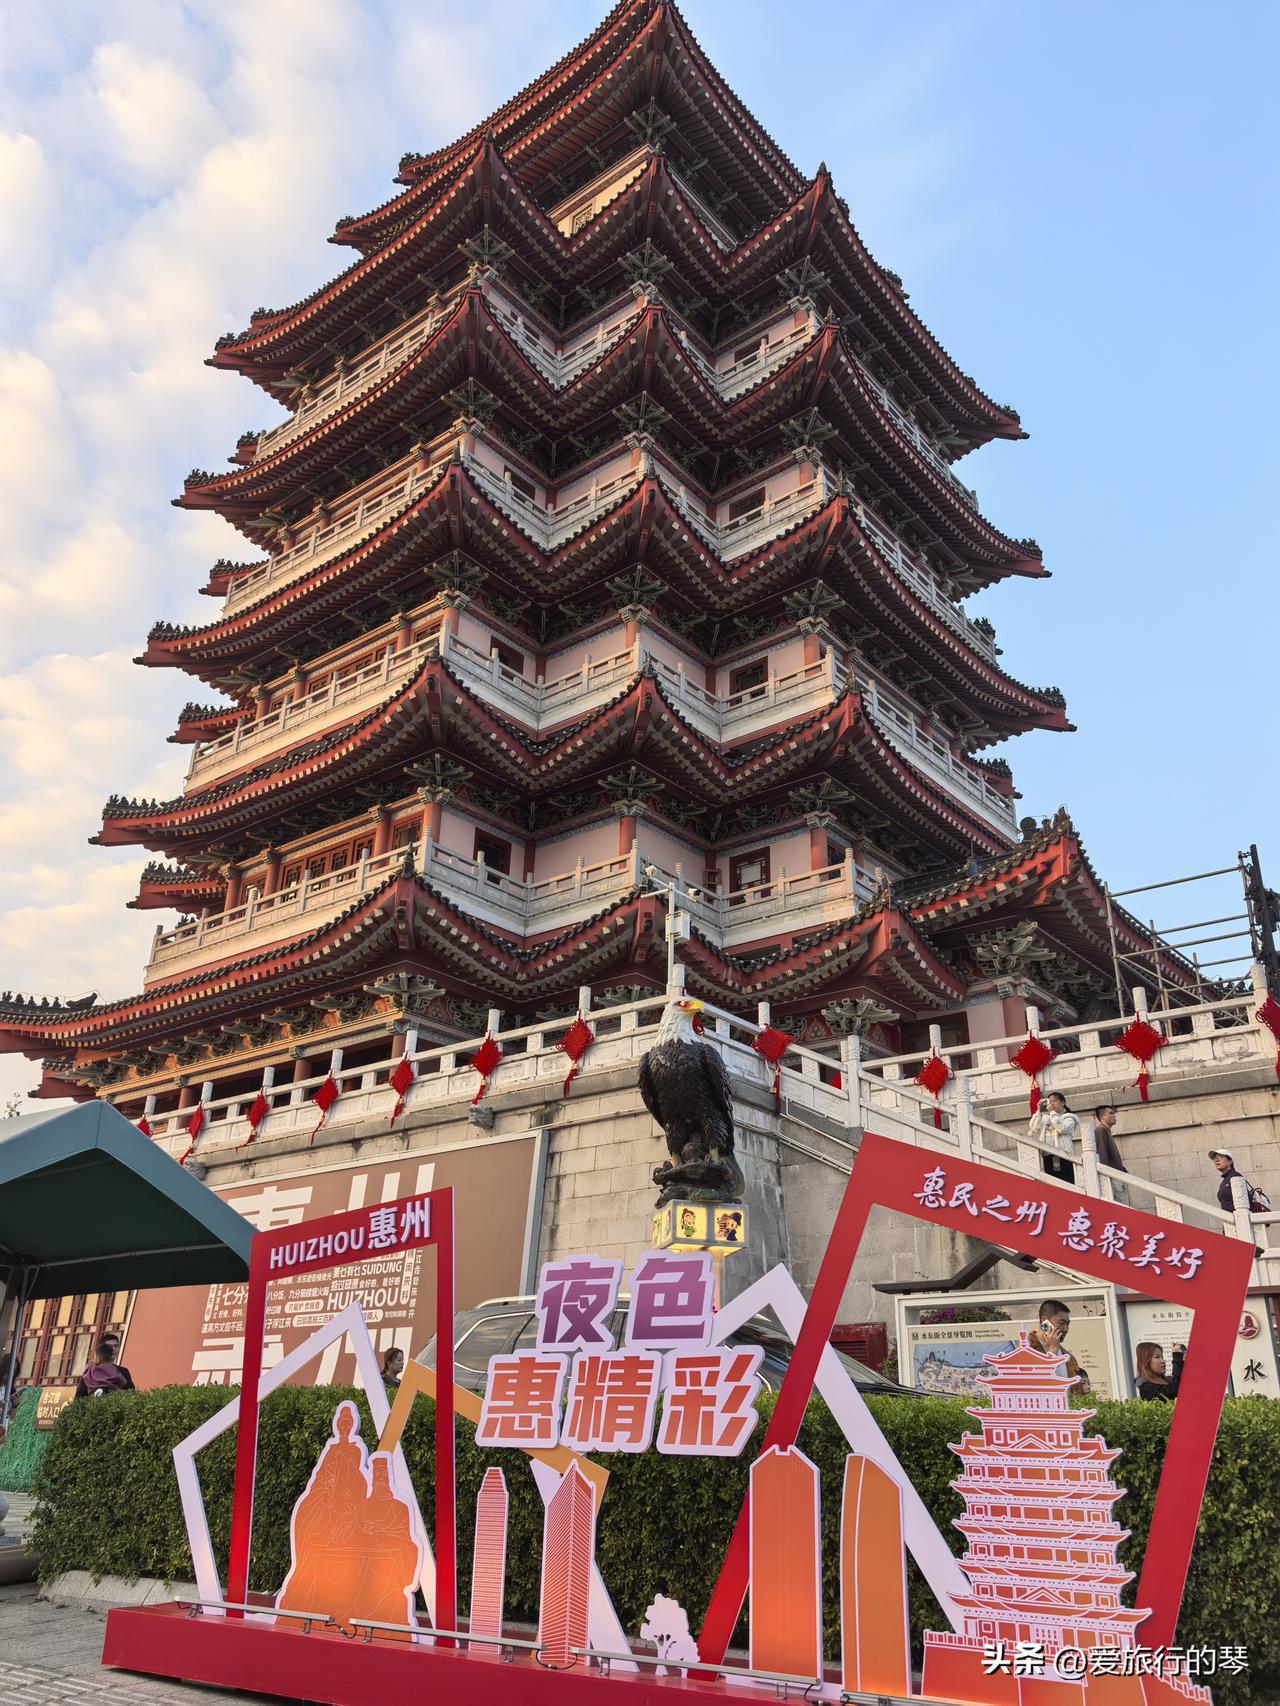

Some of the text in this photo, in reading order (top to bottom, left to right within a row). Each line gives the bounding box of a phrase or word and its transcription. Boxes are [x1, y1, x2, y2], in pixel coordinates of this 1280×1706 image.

[269, 1226, 365, 1270] HUIZHOU
[367, 1197, 432, 1250] 惠州
[912, 1165, 1205, 1280] 惠民之州 惠聚美好
[361, 1261, 403, 1276] SUIDUNG
[541, 1257, 706, 1344] 夜色
[481, 1354, 755, 1448] 惠精彩
[1243, 1358, 1266, 1382] 水
